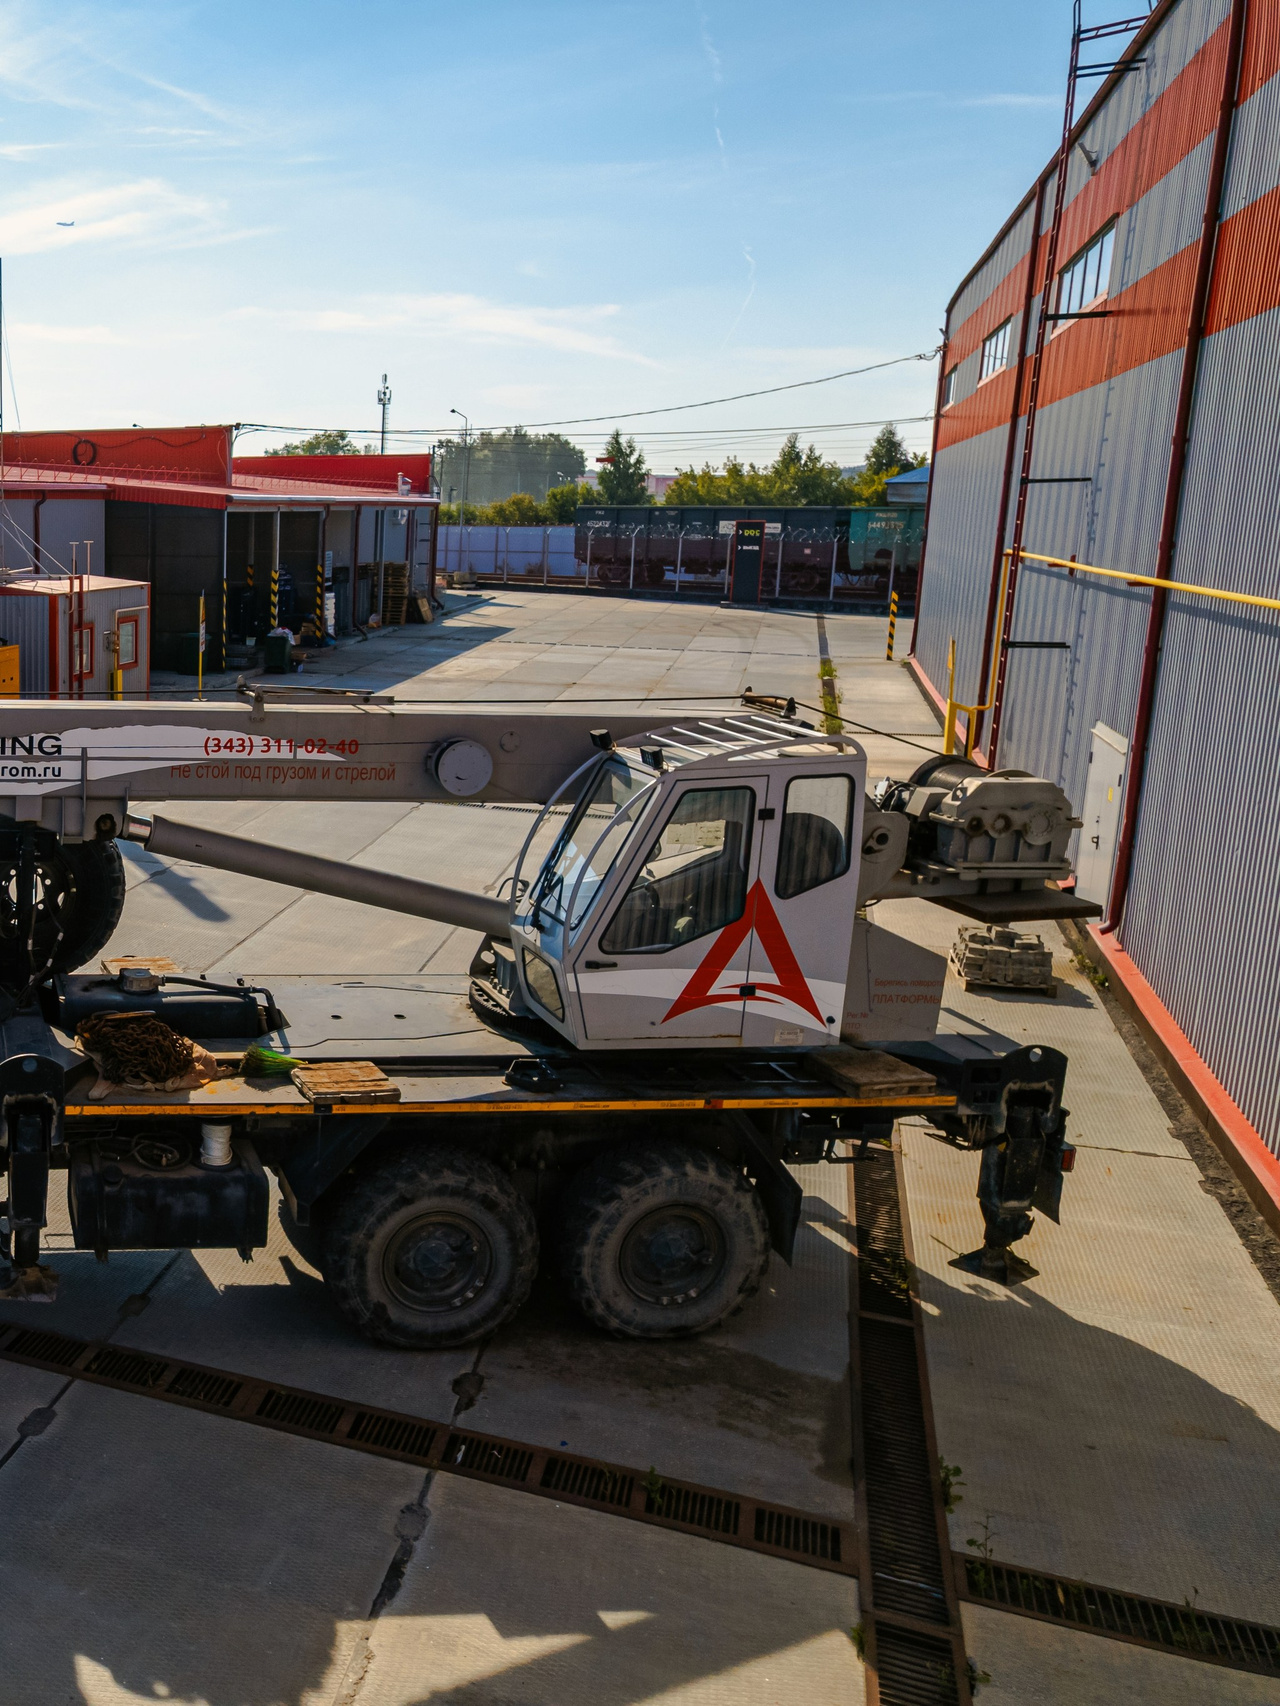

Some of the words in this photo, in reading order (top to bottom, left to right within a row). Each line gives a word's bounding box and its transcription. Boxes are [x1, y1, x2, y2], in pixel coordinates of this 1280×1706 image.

[204, 736, 254, 756] (343)
[260, 738, 360, 755] 311-02-40
[170, 765, 192, 779] Не
[195, 761, 229, 779] стой
[234, 766, 262, 782] под
[266, 766, 317, 784] грузом
[322, 767, 331, 779] и
[335, 763, 396, 784] стрелой
[872, 993, 942, 1004] ПЛАТФОРМЫ
